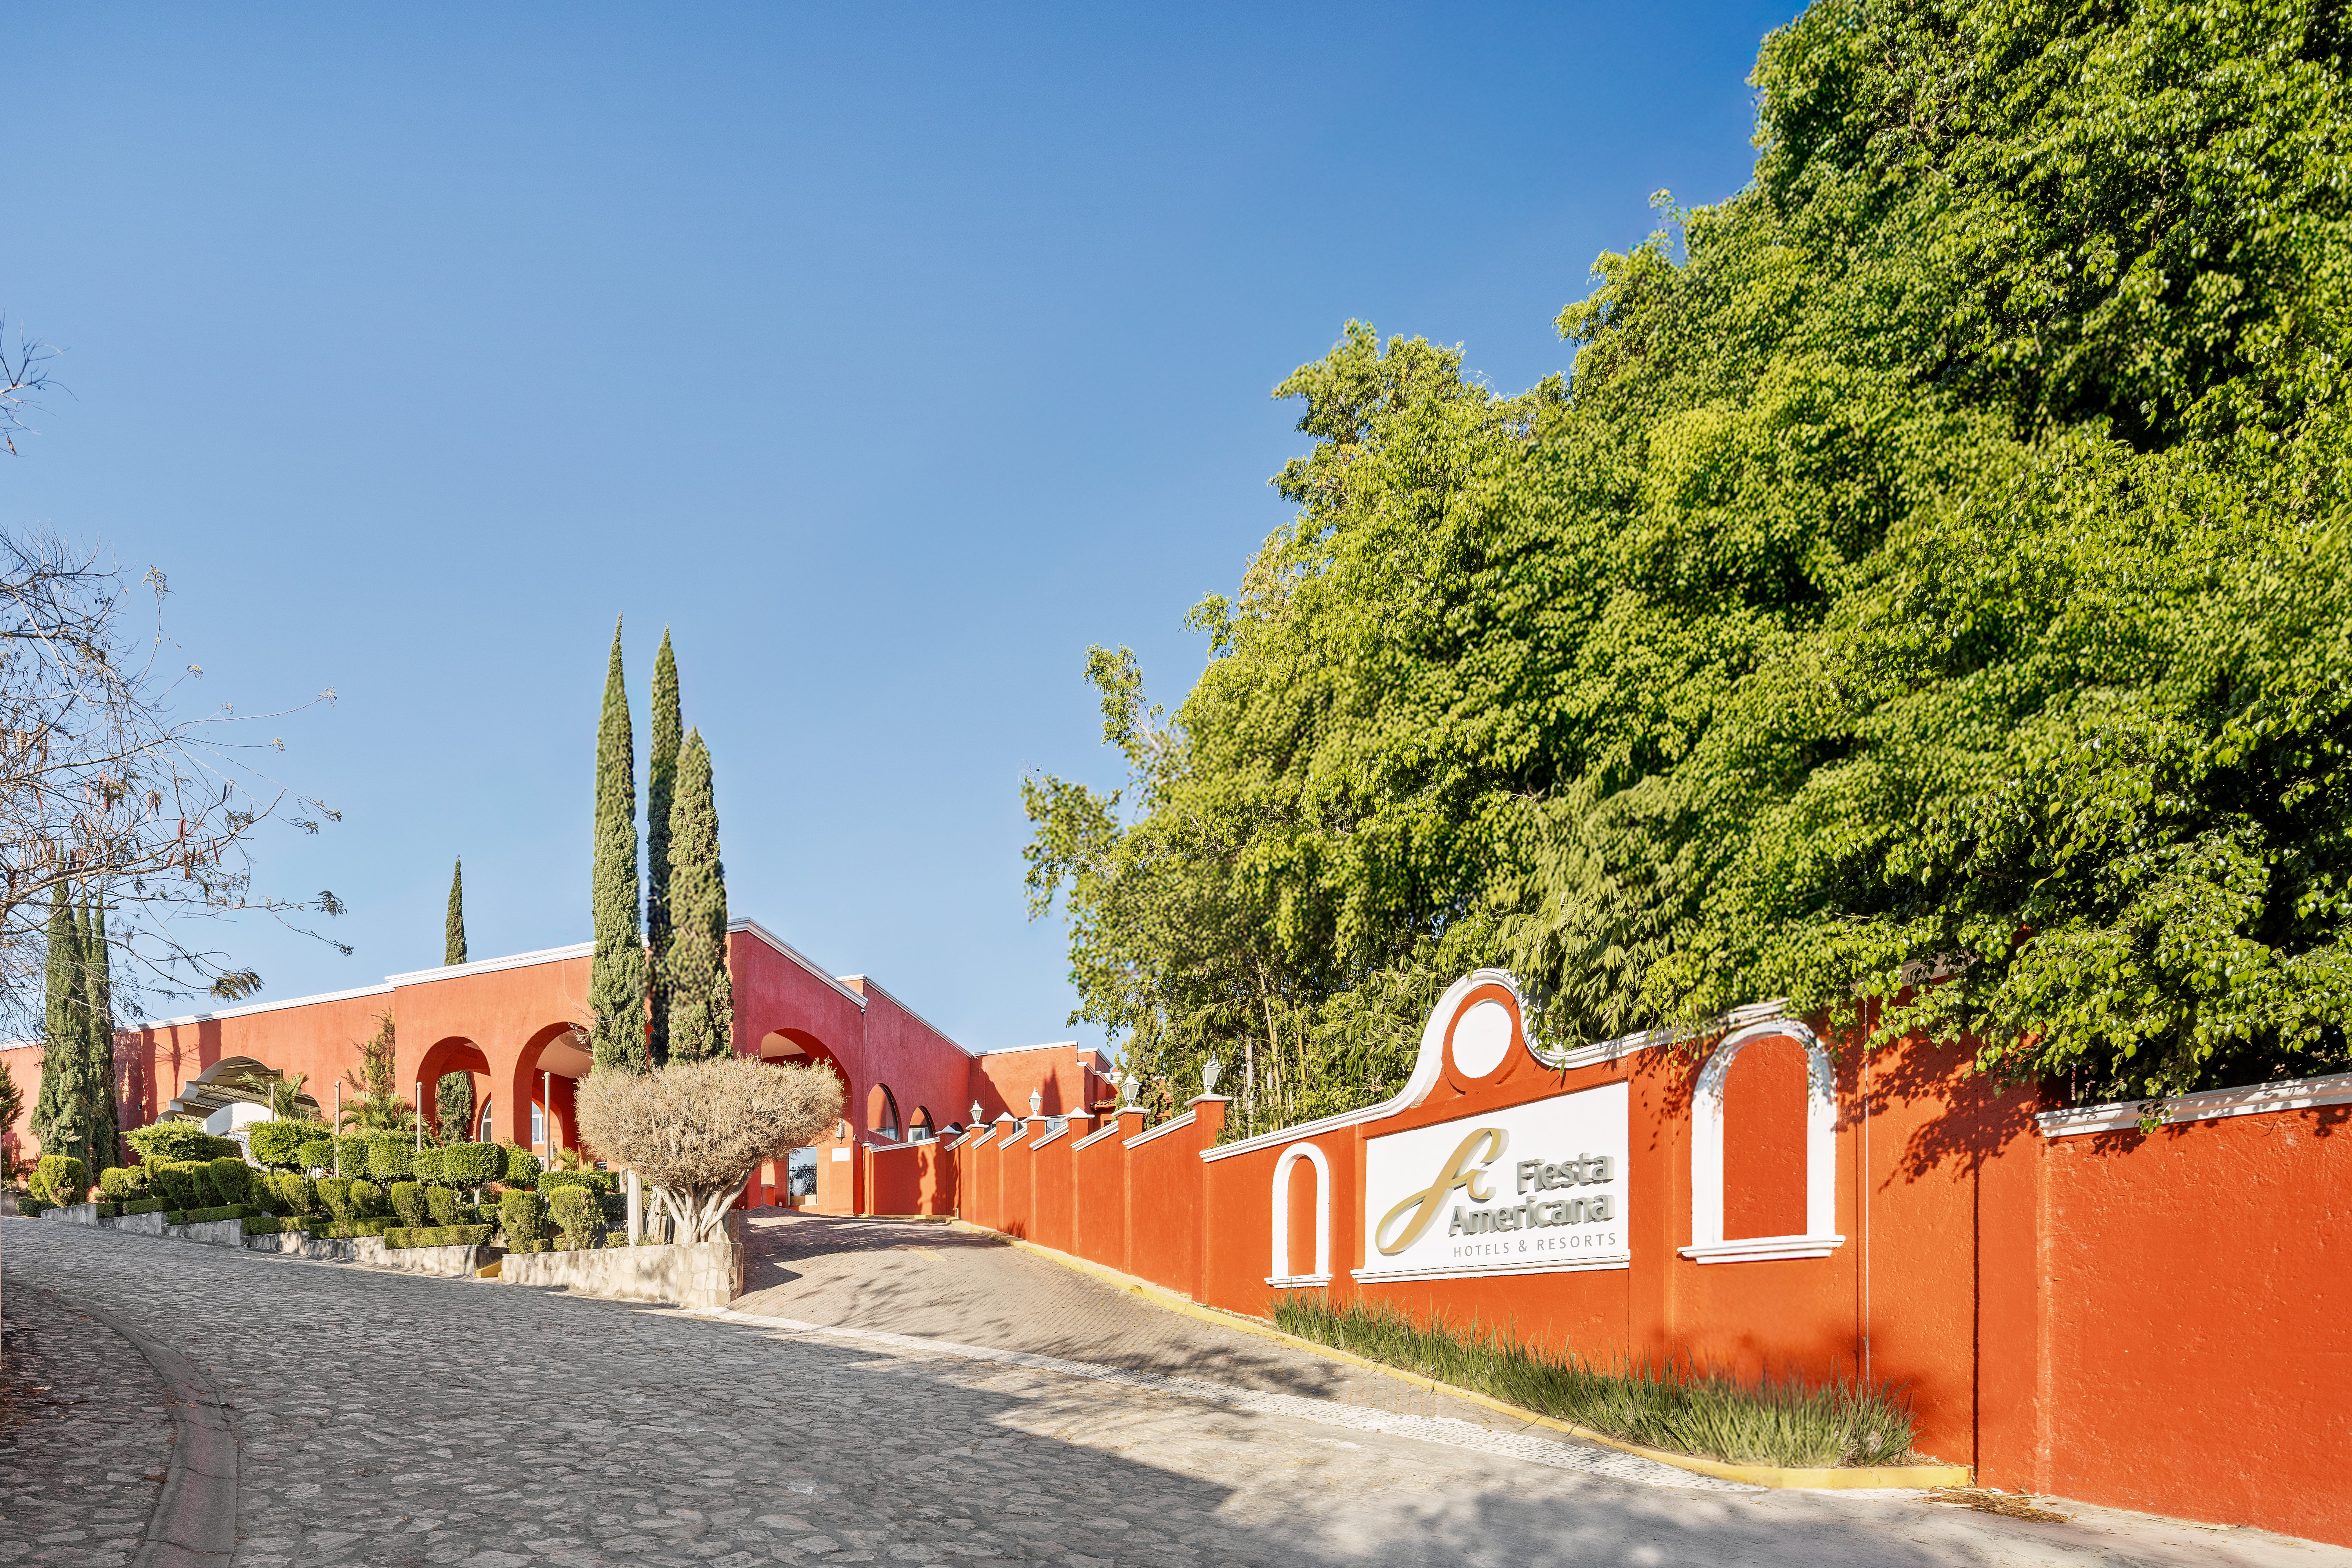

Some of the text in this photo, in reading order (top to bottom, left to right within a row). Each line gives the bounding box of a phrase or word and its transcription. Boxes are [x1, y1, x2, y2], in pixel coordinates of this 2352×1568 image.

[1517, 1152, 1615, 1194] Fiesta
[1448, 1194, 1615, 1236] Americana
[1454, 1233, 1615, 1258] HOTELS & RESORTS
